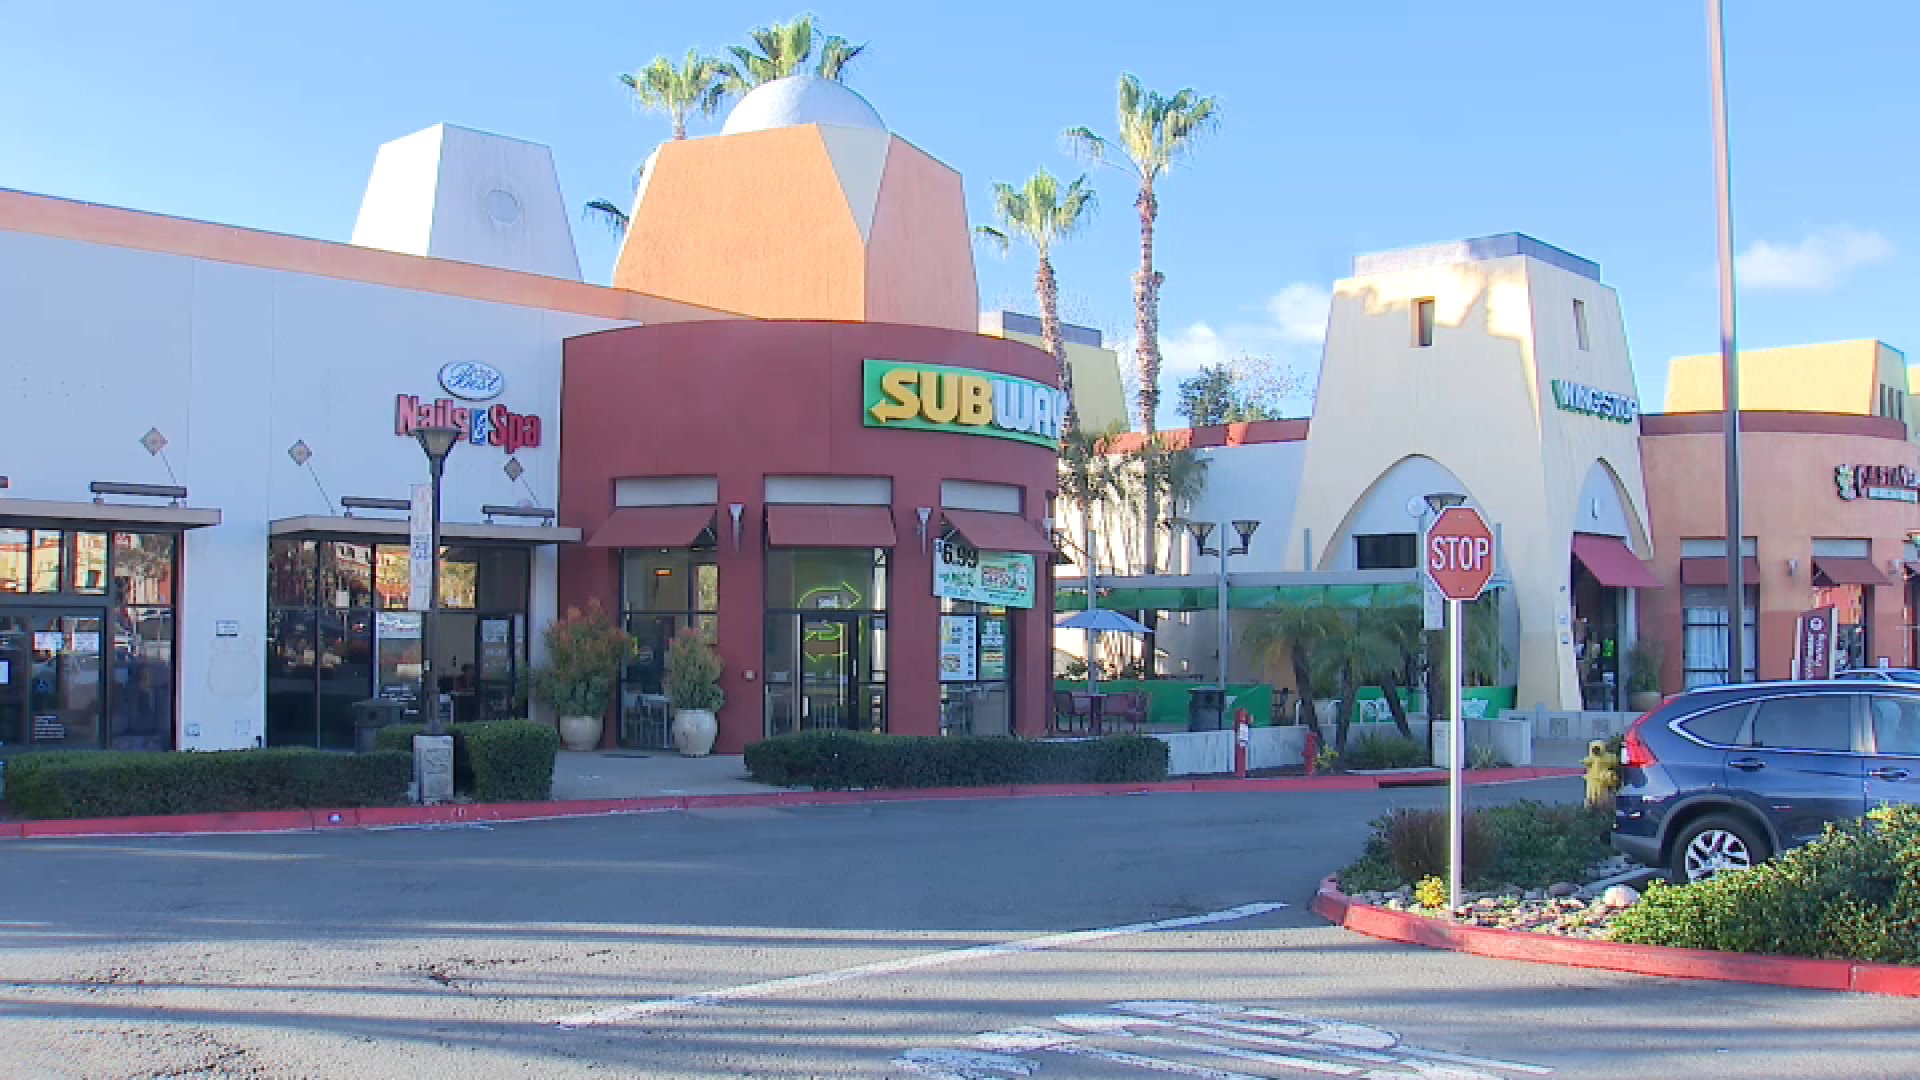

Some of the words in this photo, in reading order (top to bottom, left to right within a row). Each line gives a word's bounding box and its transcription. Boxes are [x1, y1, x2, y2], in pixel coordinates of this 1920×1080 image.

[395, 393, 469, 440] Nails
[488, 404, 543, 454] Spa
[869, 368, 1070, 440] SUBWAY
[1431, 536, 1489, 571] STOP
